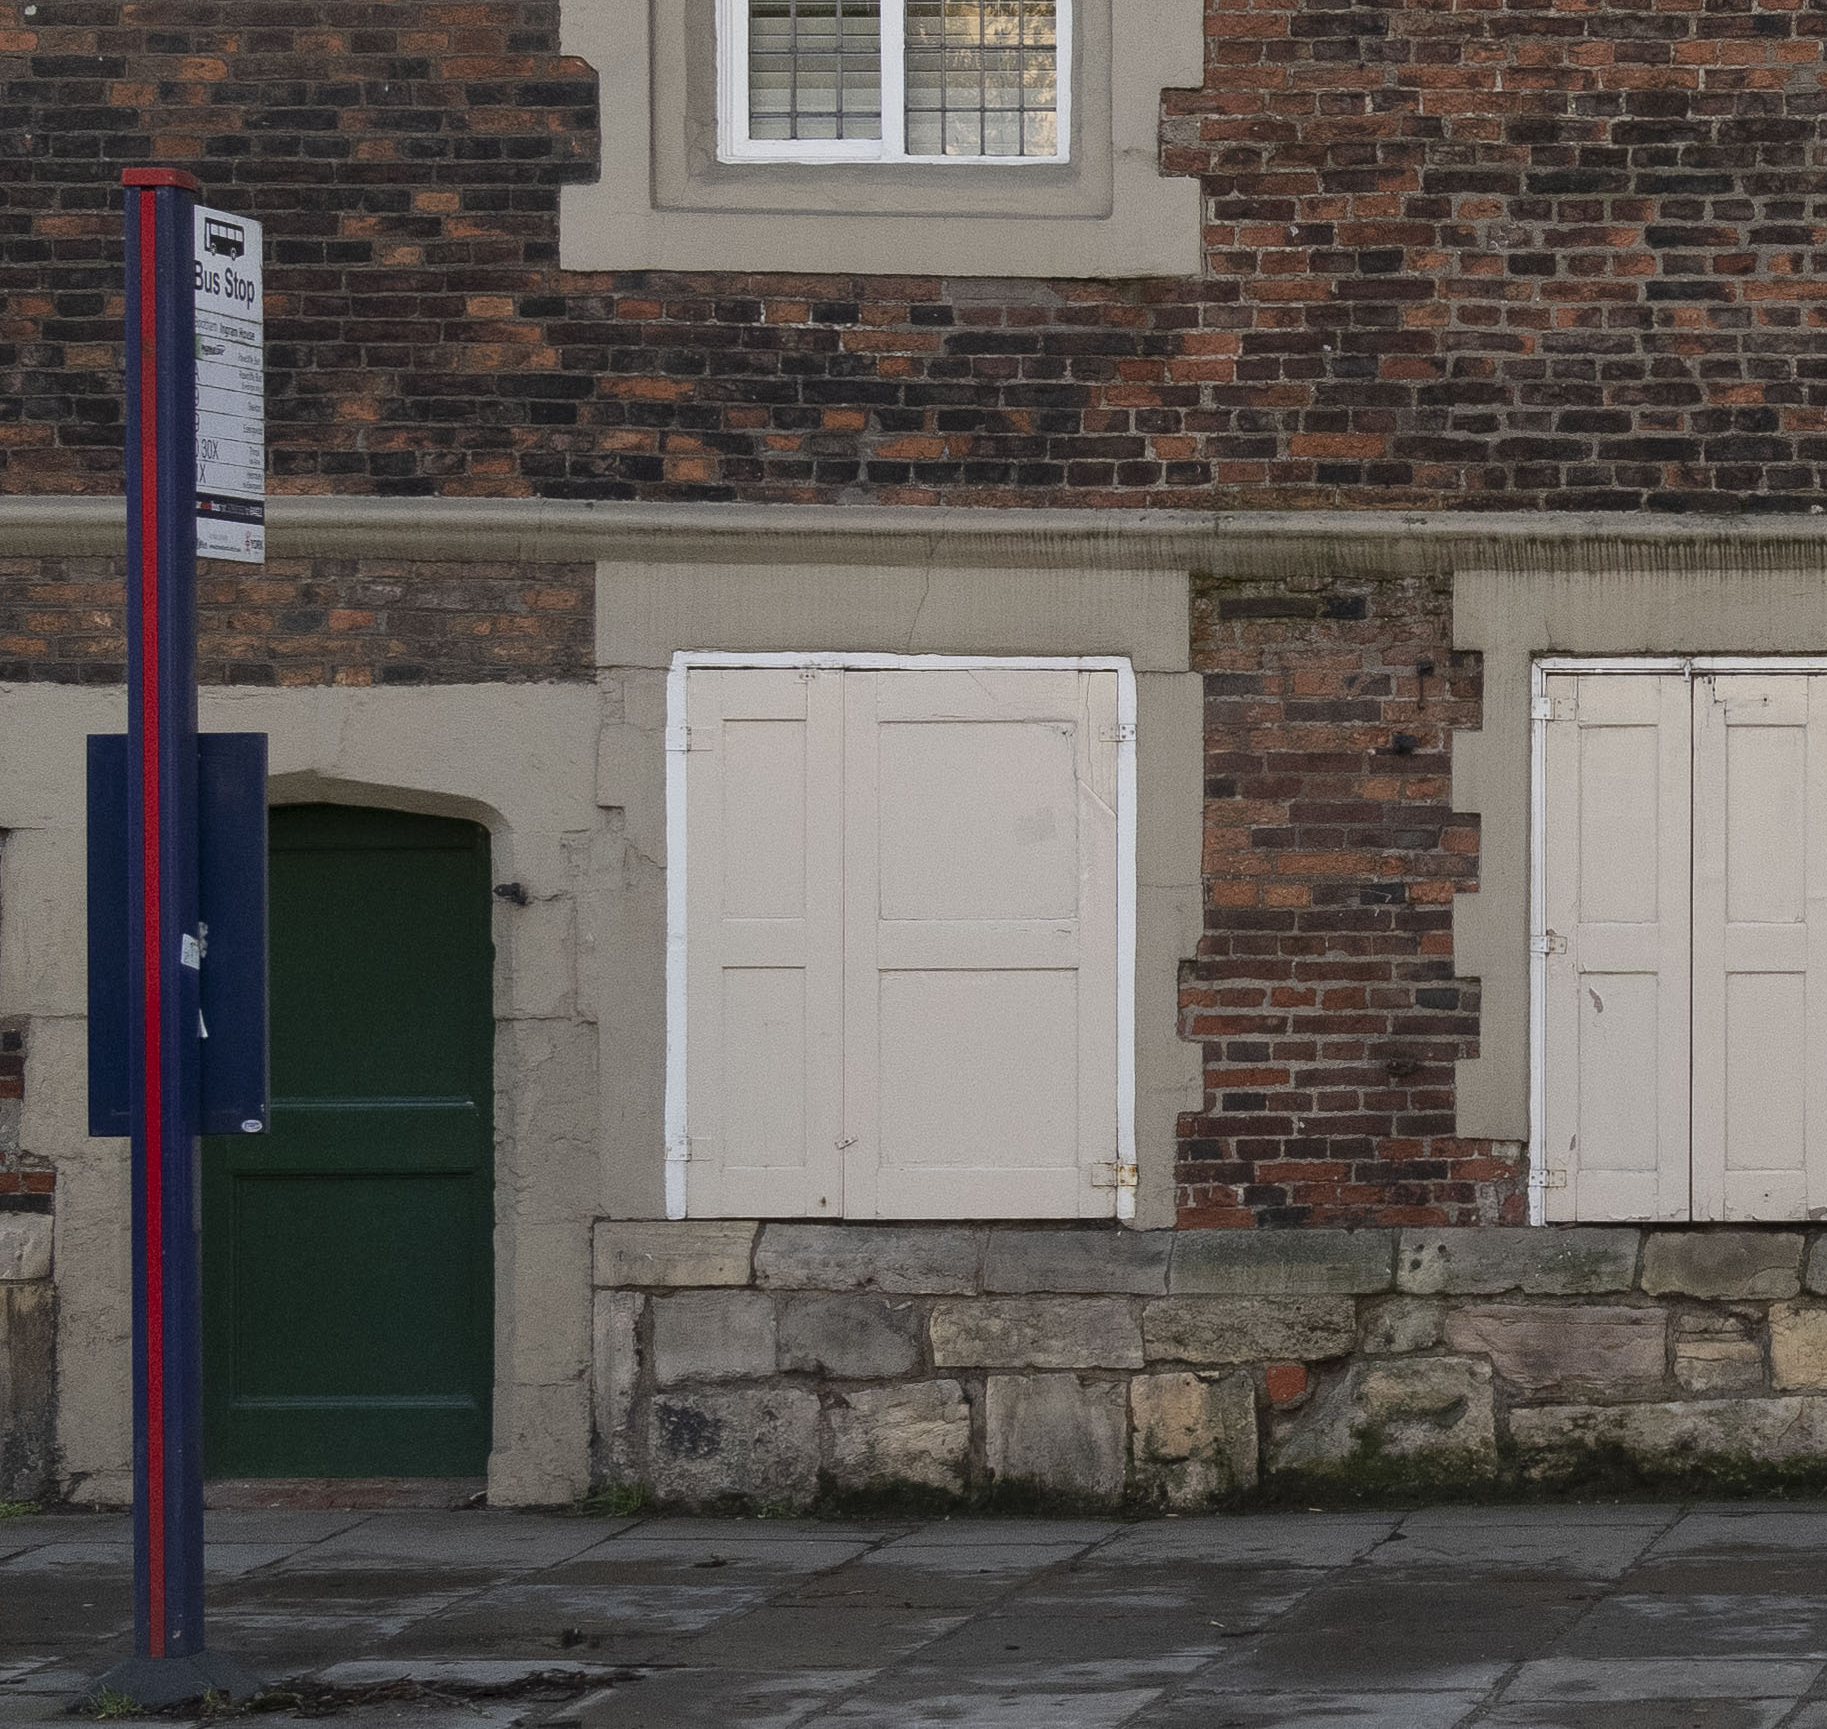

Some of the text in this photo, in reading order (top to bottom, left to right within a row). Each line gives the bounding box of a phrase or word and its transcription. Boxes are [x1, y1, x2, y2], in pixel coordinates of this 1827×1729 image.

[194, 259, 255, 310] Bus Stop
[201, 438, 219, 460] 30X
